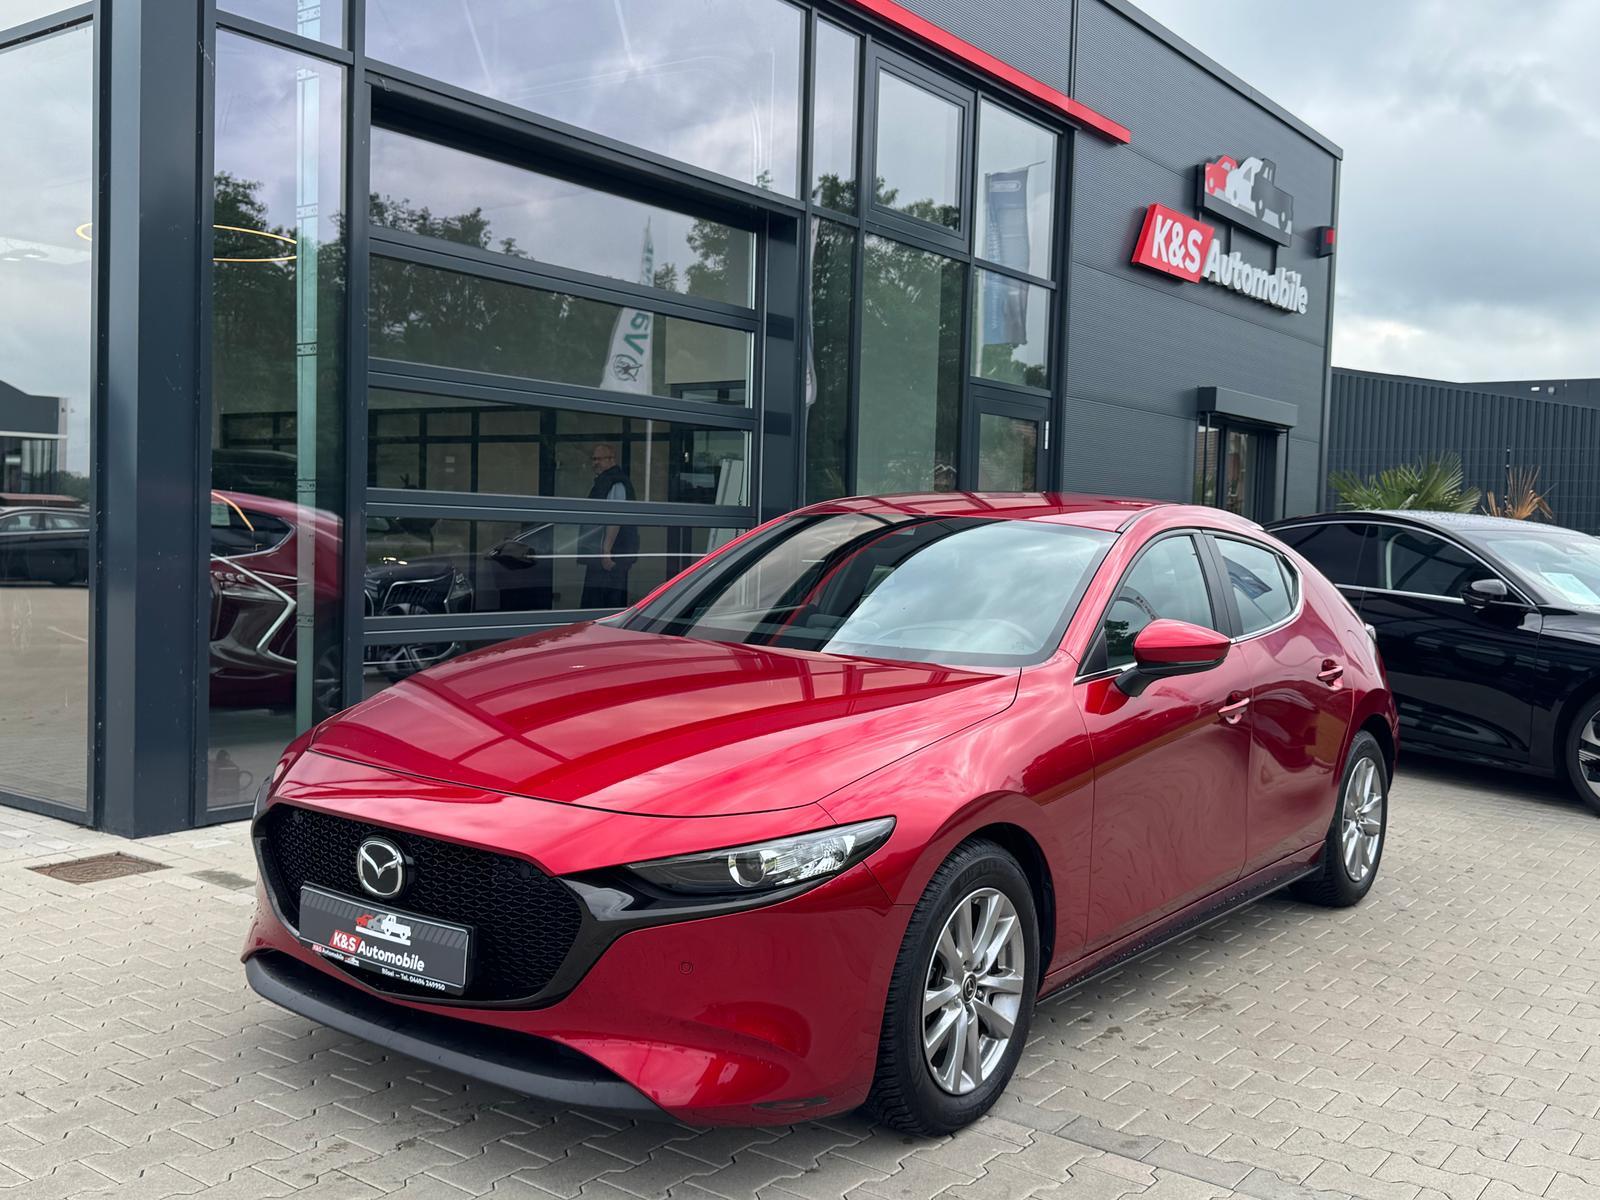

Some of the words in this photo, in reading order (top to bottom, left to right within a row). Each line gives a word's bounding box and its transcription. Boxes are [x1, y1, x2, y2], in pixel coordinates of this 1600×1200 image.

[1151, 214, 1203, 274] K&S
[1202, 238, 1308, 315] Automobile
[332, 931, 357, 952] K&S
[357, 940, 425, 972] Automobile
